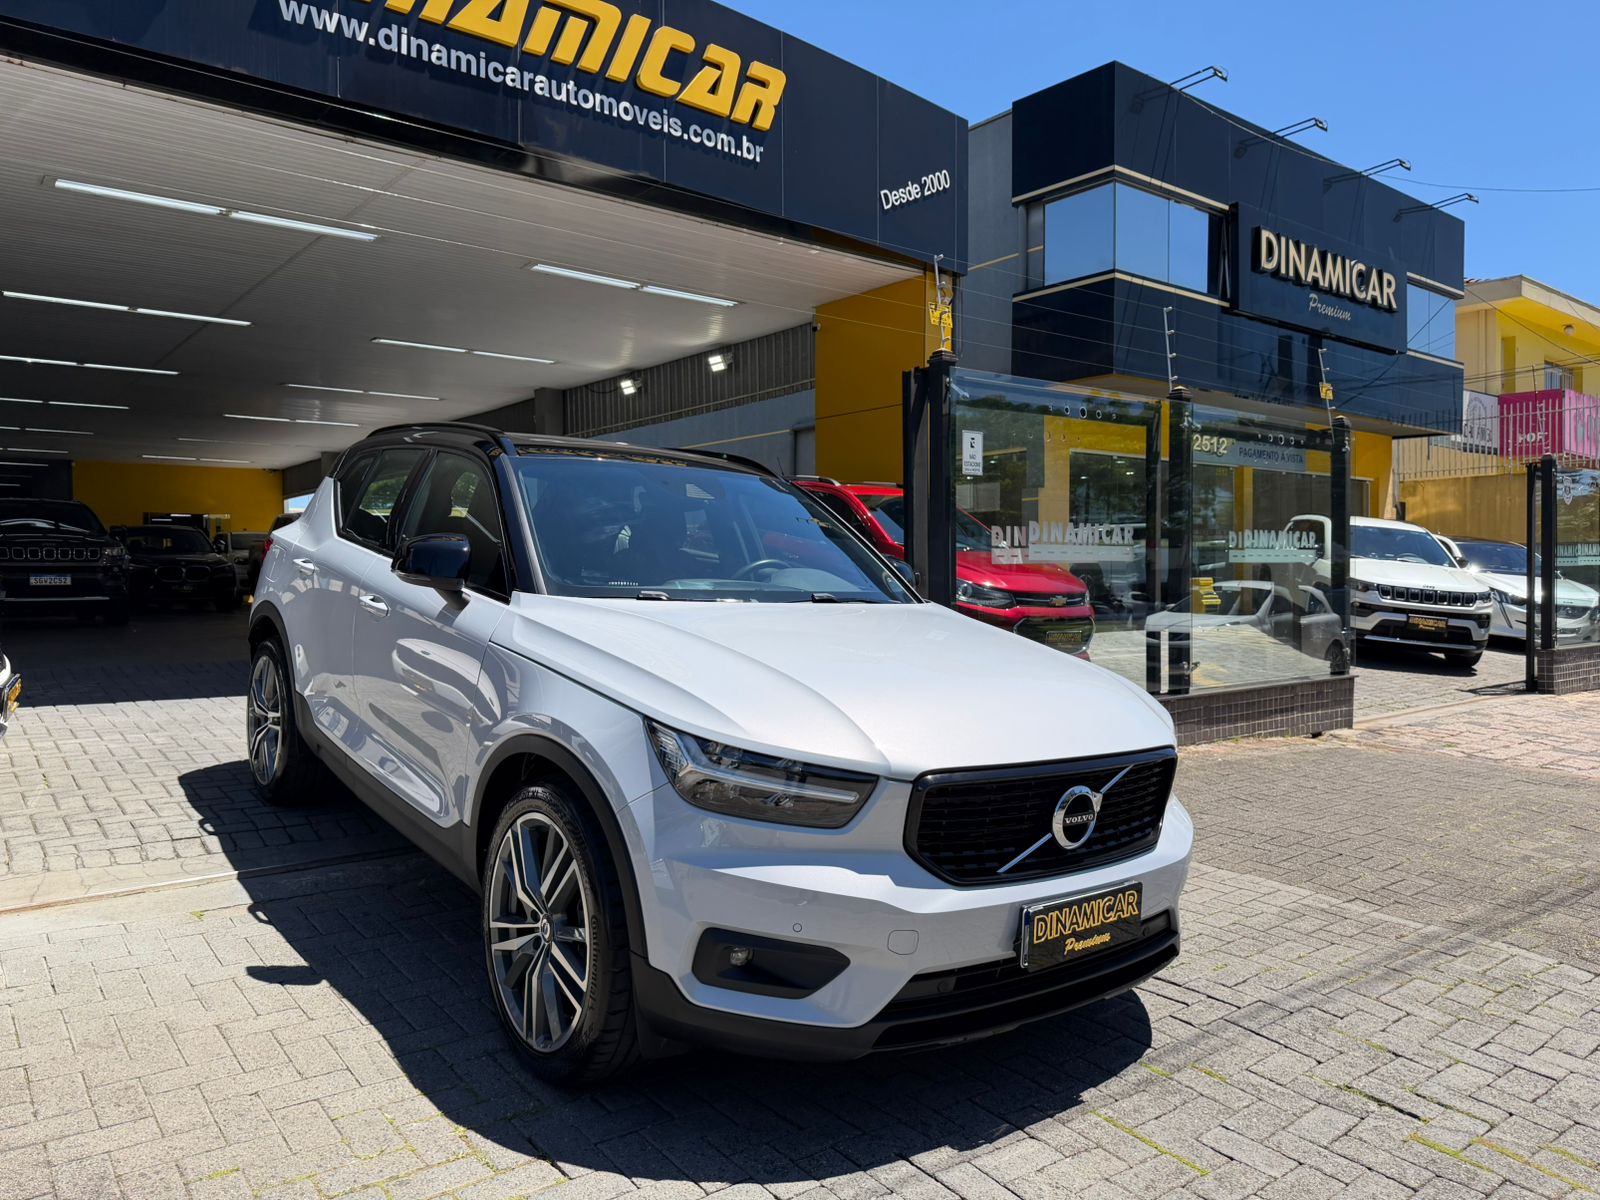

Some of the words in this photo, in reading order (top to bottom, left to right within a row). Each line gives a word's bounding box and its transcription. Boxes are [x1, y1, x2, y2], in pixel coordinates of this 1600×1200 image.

[277, 0, 764, 163] www.dinamicarautomoveis.com.br
[880, 181, 922, 210] Desde
[921, 169, 950, 196] 2000
[1261, 229, 1397, 309] DINAMICAR
[1308, 293, 1352, 321] Premium
[1192, 433, 1229, 455] 2512
[1028, 520, 1135, 545] DINAMICAR
[1064, 813, 1094, 824] VOLVO
[1033, 890, 1139, 944] DINAMICAR
[1064, 932, 1112, 956] Premium
